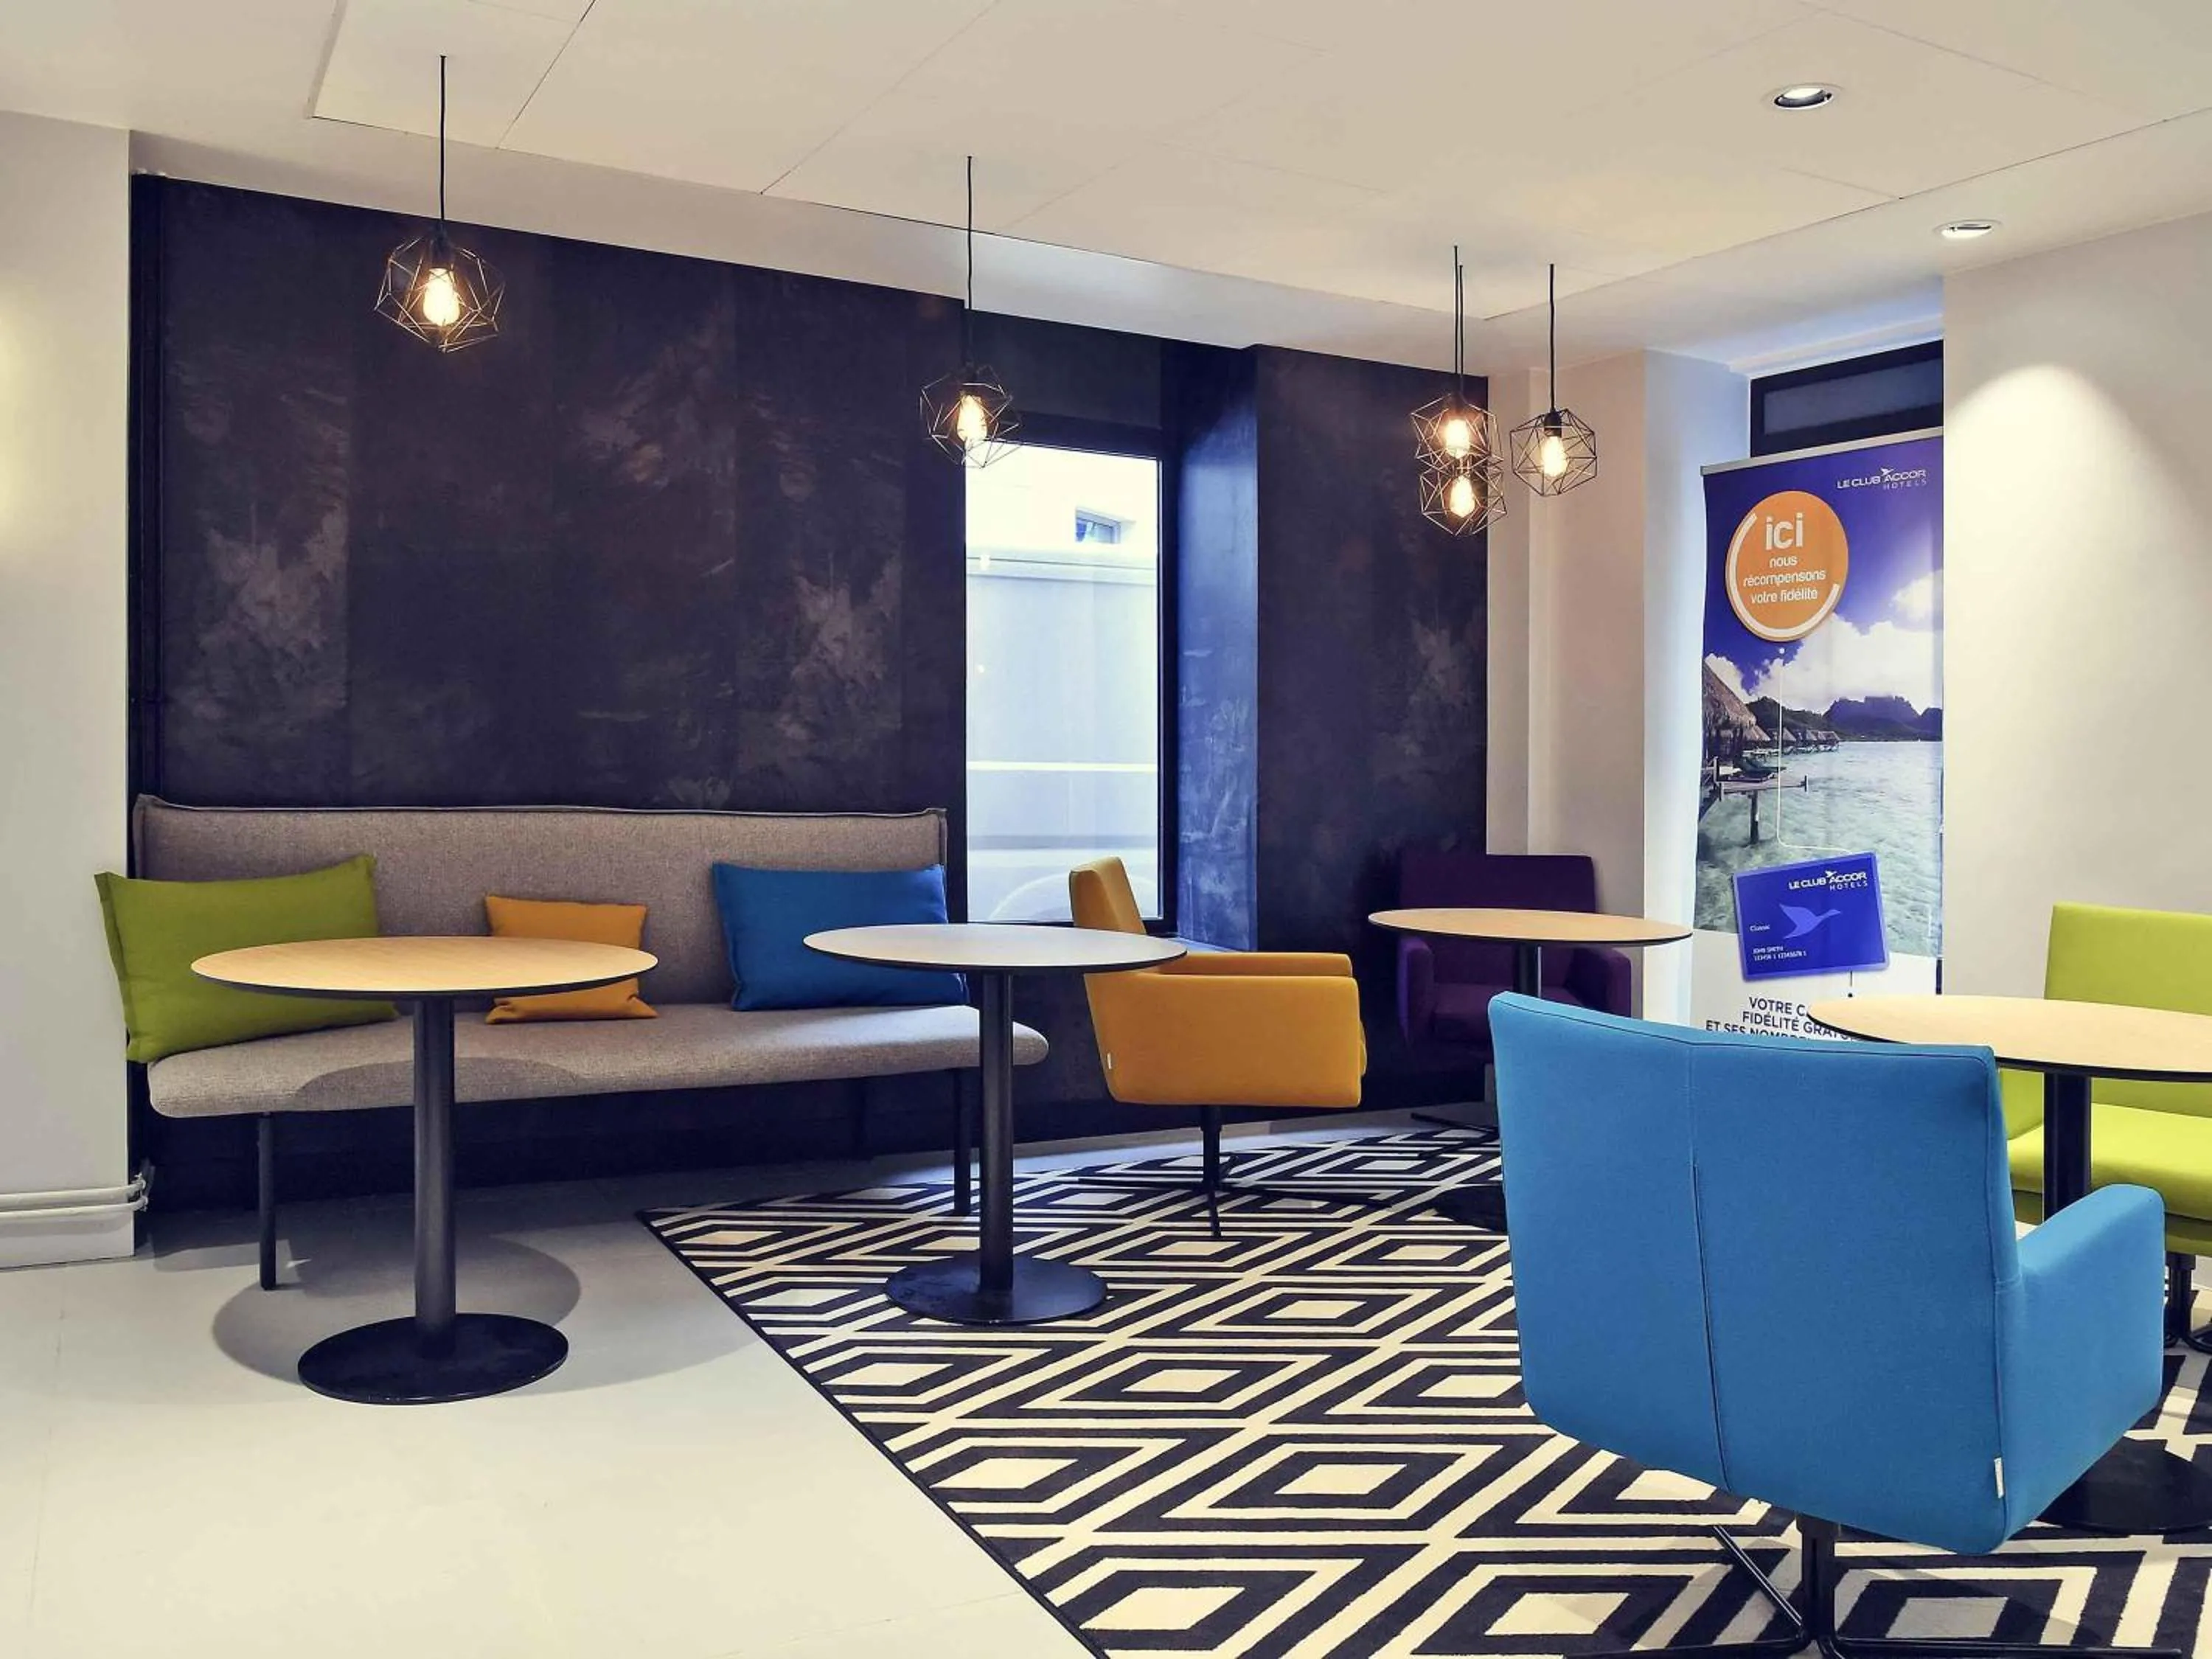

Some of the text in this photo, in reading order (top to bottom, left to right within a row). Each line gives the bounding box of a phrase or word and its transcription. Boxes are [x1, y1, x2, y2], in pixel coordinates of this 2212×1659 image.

[1837, 470, 1927, 489] LE CLUB ACCOR
[1883, 479, 1927, 490] HOTELS
[1765, 512, 1804, 551] ici
[1769, 556, 1798, 568] nous
[1750, 591, 1778, 604] votre
[1788, 872, 1868, 890] LE CLUB ACCOR
[1829, 880, 1868, 891] HOTELS
[1748, 996, 1792, 1015] VOTRE
[1705, 1020, 1721, 1032] ET
[1742, 1011, 1800, 1032] FIDÉLITÉ
